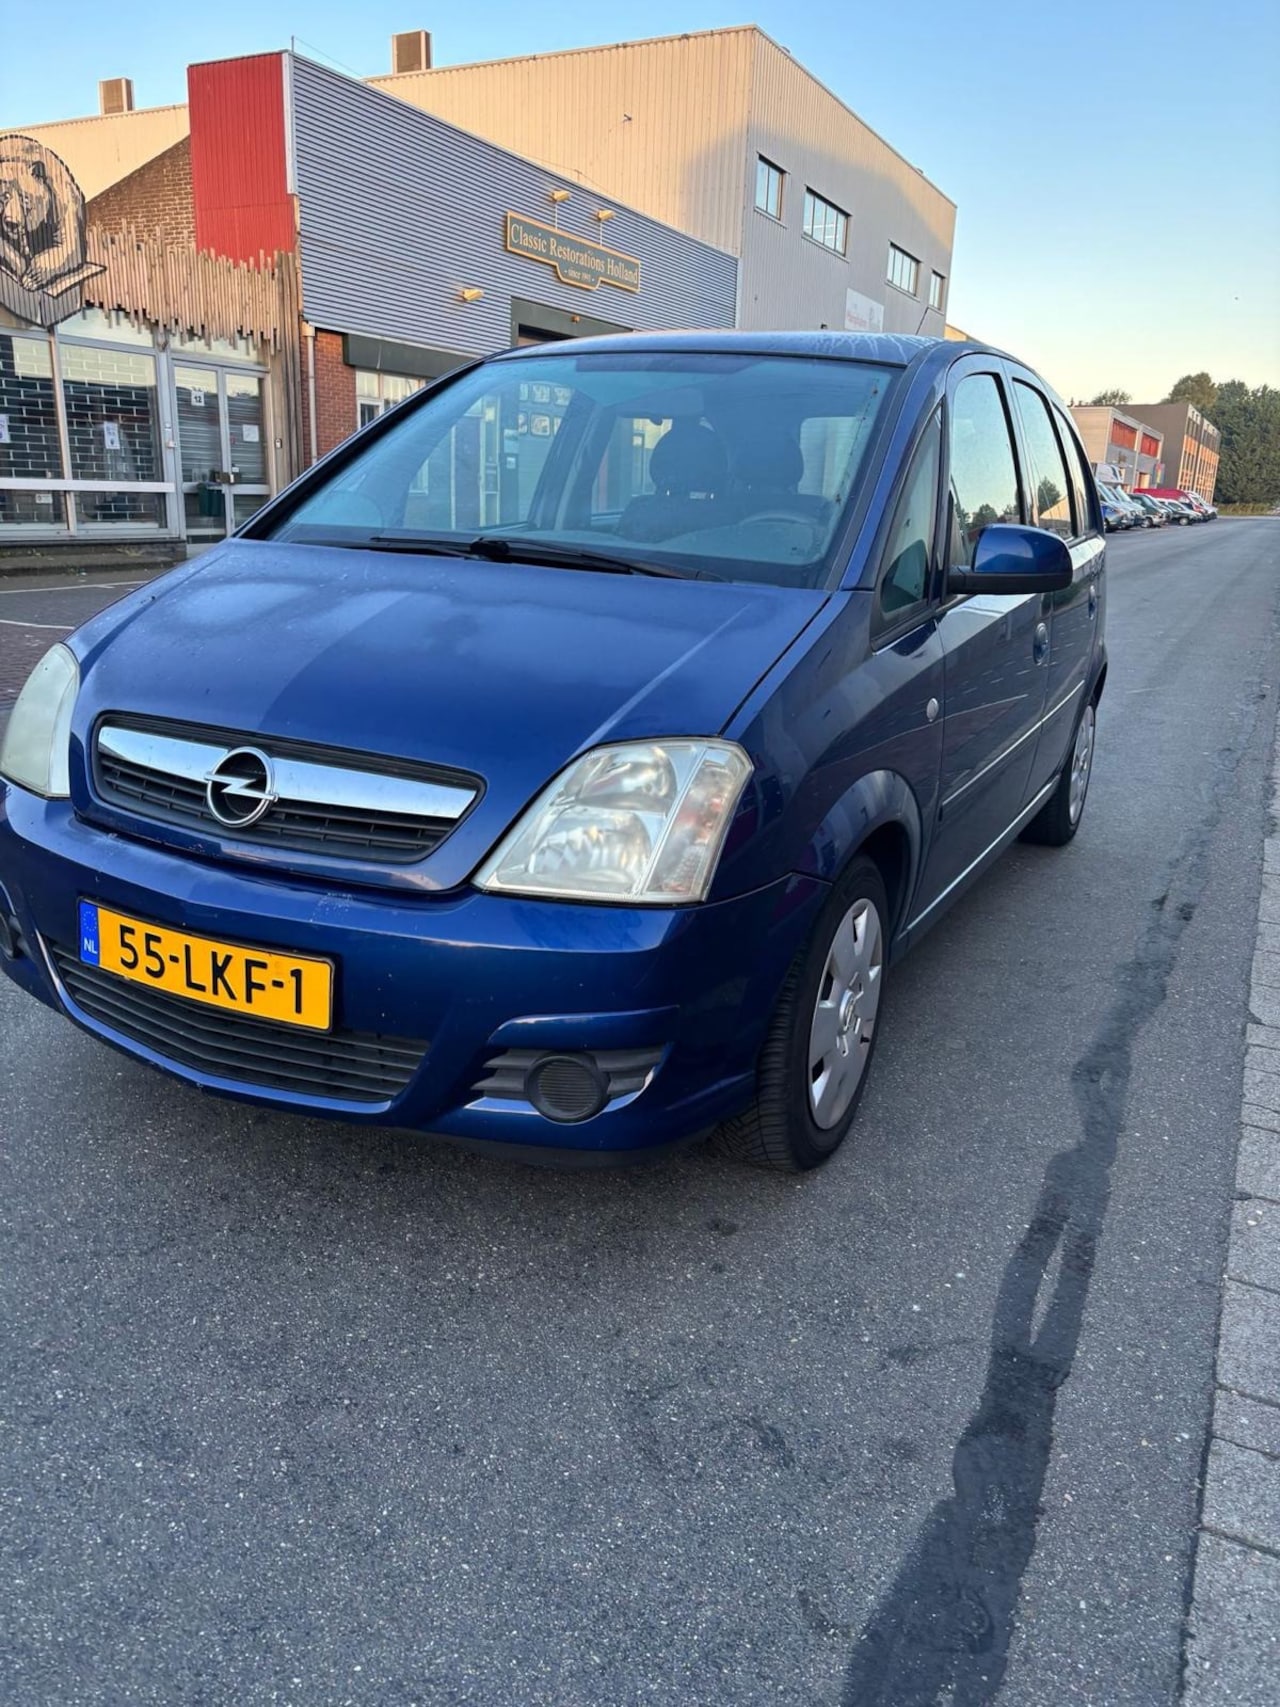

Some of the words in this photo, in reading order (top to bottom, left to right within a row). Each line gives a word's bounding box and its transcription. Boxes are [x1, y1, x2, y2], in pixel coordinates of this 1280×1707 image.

[511, 223, 547, 253] Classic
[550, 238, 605, 272] Restorations
[607, 258, 638, 284] Holland
[194, 395, 202, 403] 12
[84, 937, 98, 954] NL
[119, 924, 303, 1014] 55-LKF-1
